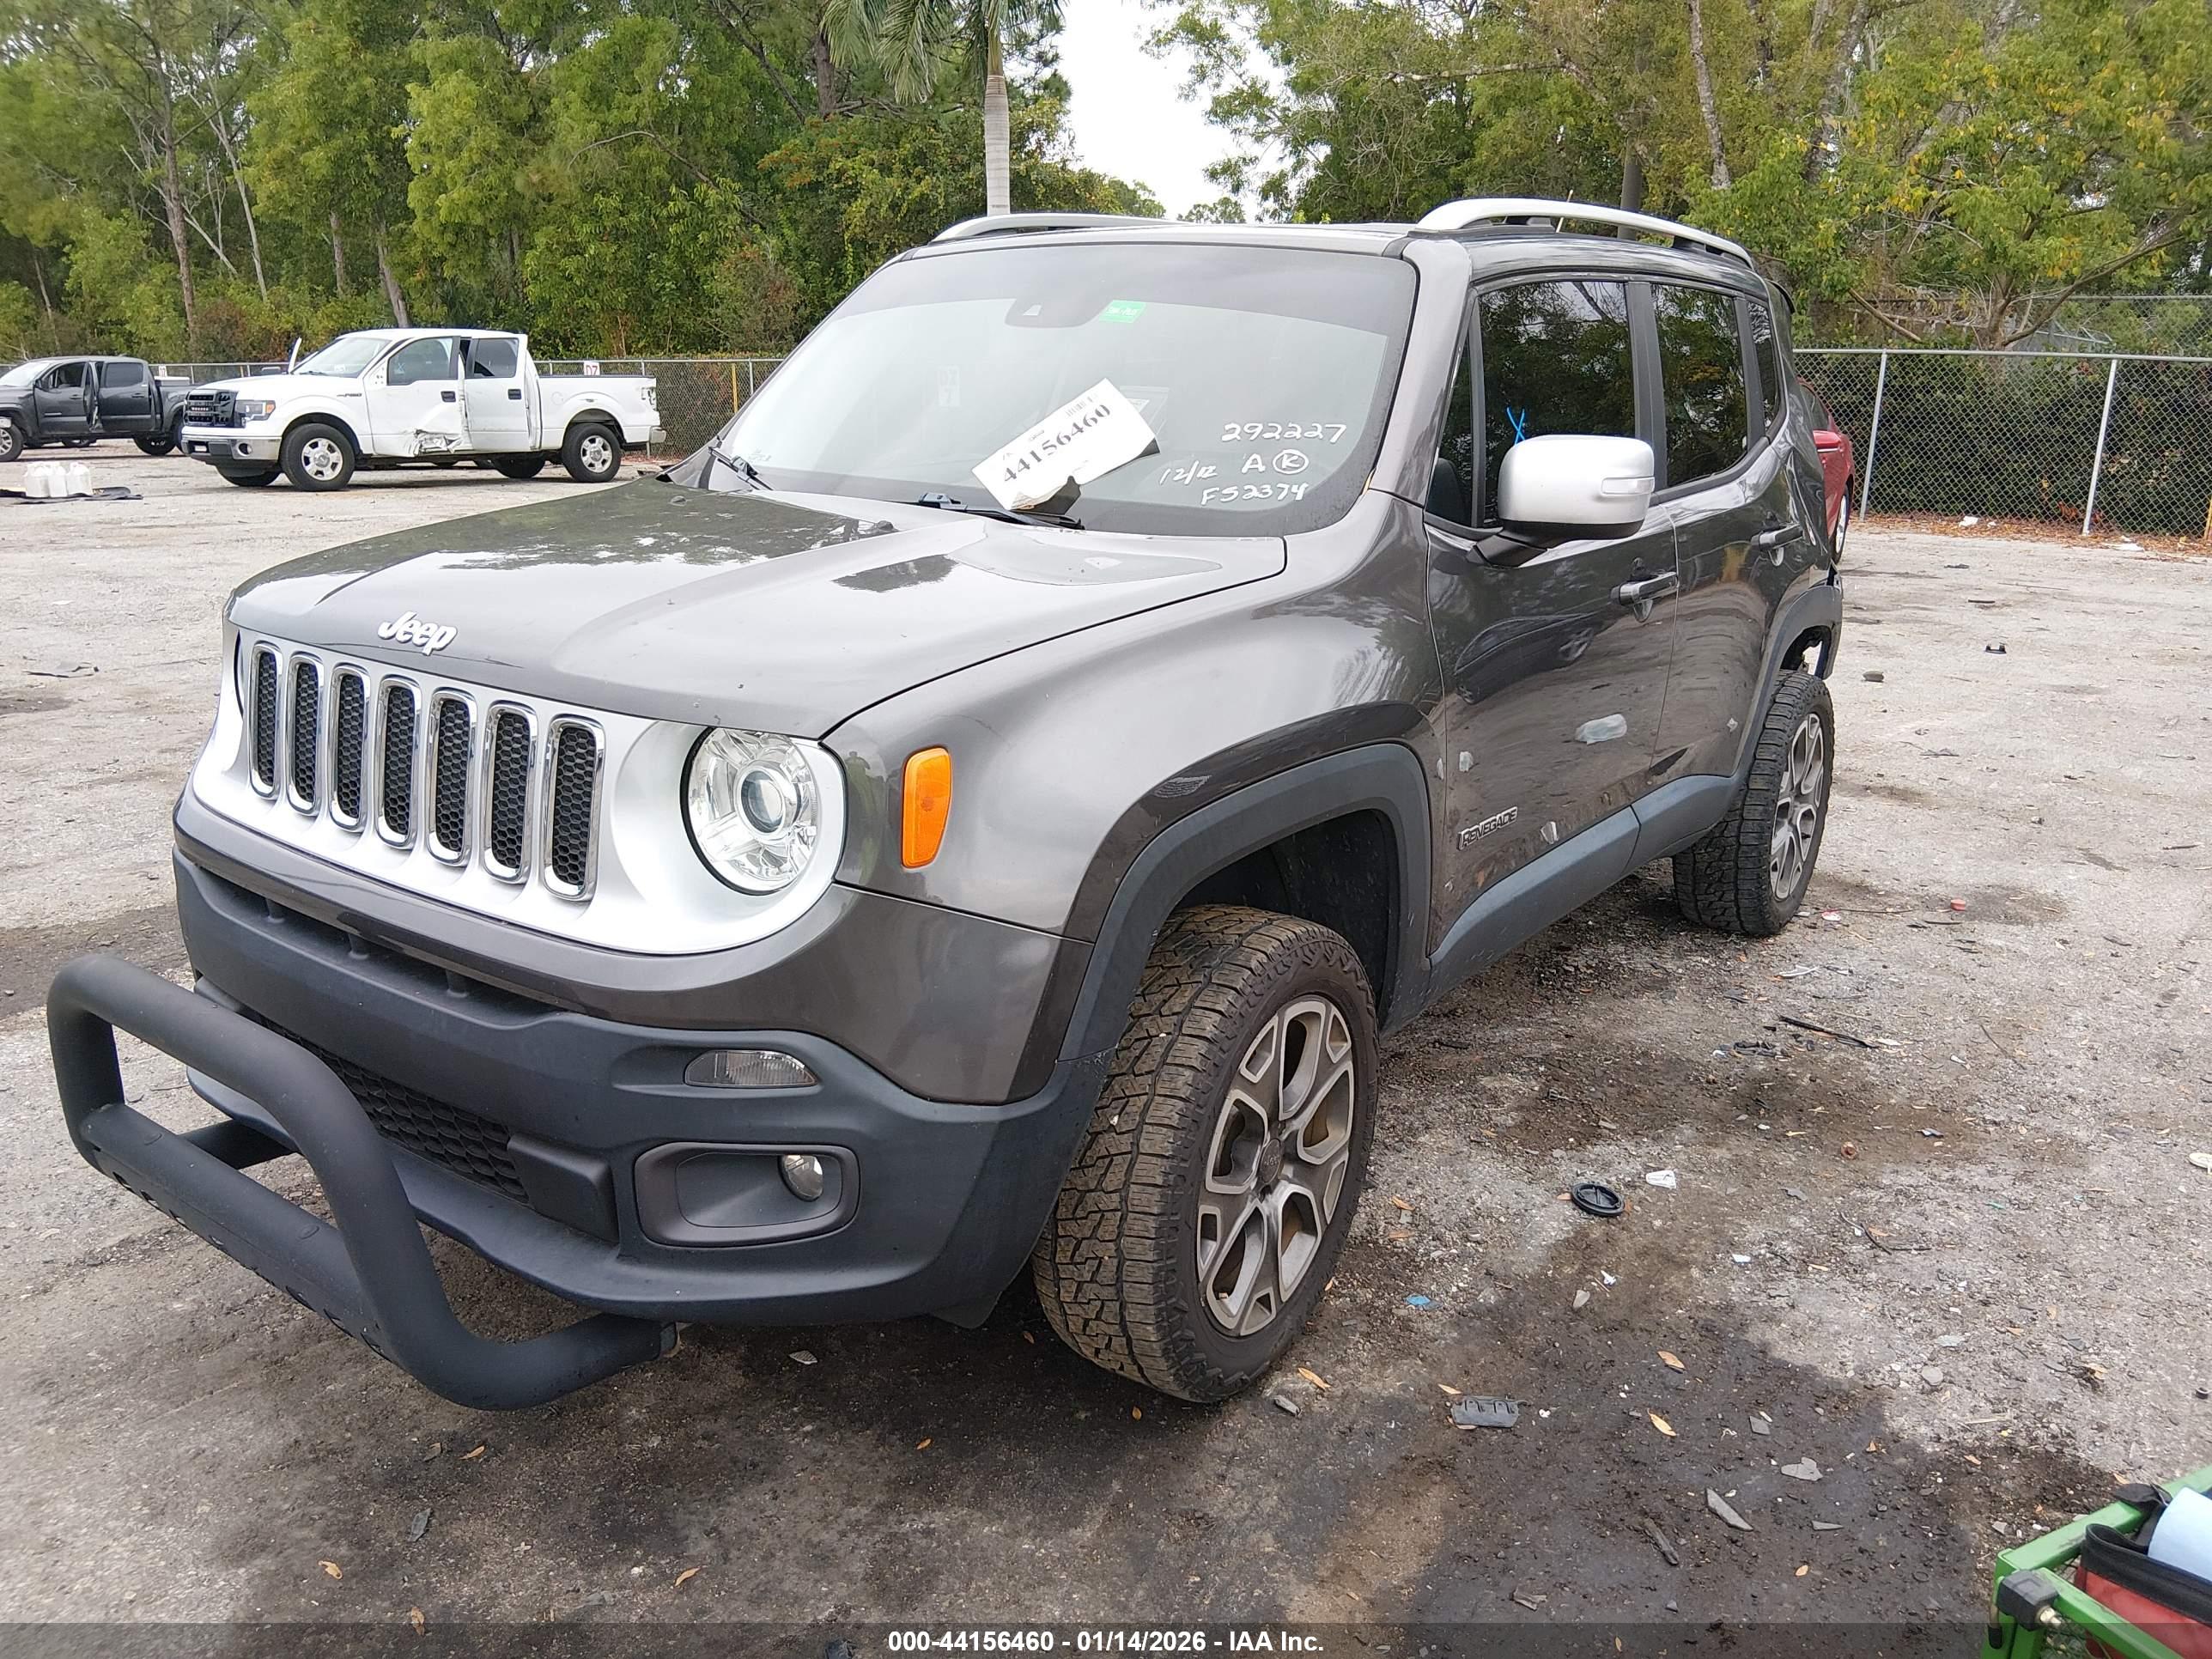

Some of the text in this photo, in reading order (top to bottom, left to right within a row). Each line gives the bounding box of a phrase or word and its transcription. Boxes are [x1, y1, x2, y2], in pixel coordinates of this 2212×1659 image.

[1003, 404, 1111, 483] 44156460
[1221, 422, 1347, 444] 292227
[1241, 453, 1266, 474] A
[378, 611, 458, 656] Jeep
[1458, 807, 1518, 849] RENEGADE
